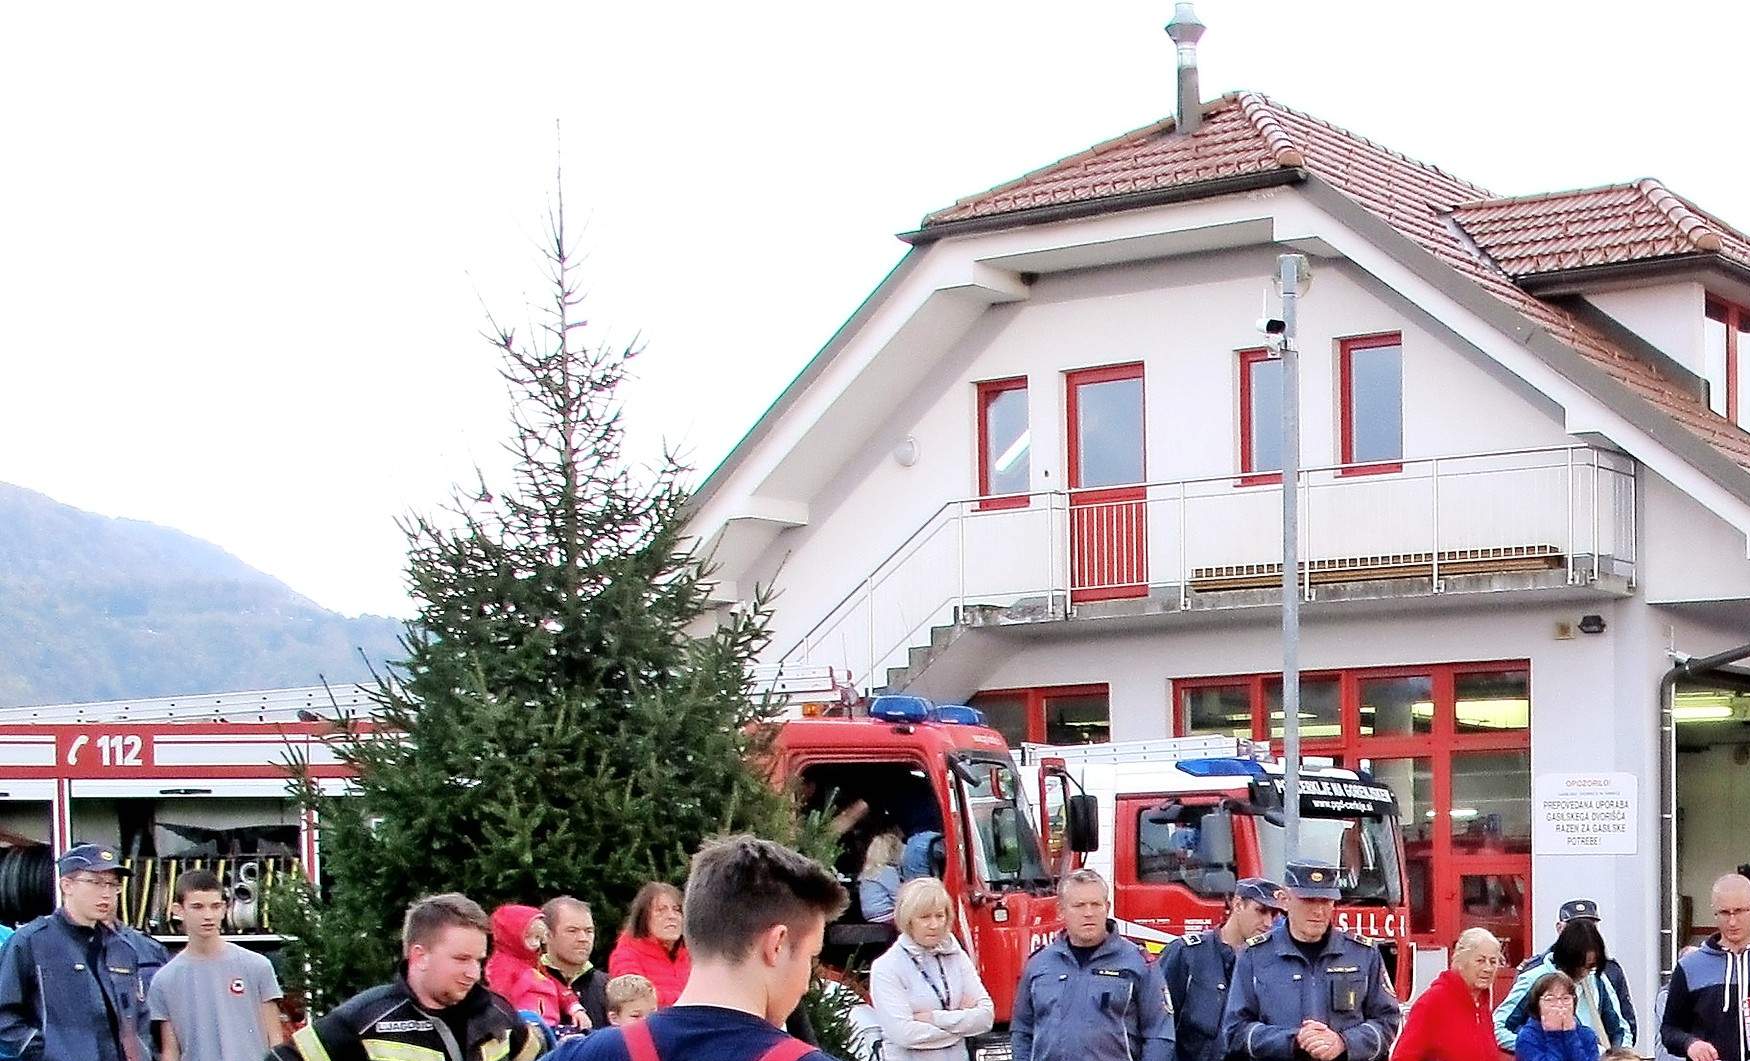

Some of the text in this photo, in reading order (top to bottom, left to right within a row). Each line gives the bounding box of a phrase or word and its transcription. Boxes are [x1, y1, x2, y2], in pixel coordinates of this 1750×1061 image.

[96, 734, 143, 766] 112
[1595, 800, 1630, 809] UPORABA
[1545, 812, 1590, 822] GASILSKEGA
[1555, 824, 1627, 833] RAZEN ZA GASILSKE
[1338, 912, 1406, 938] SILCI
